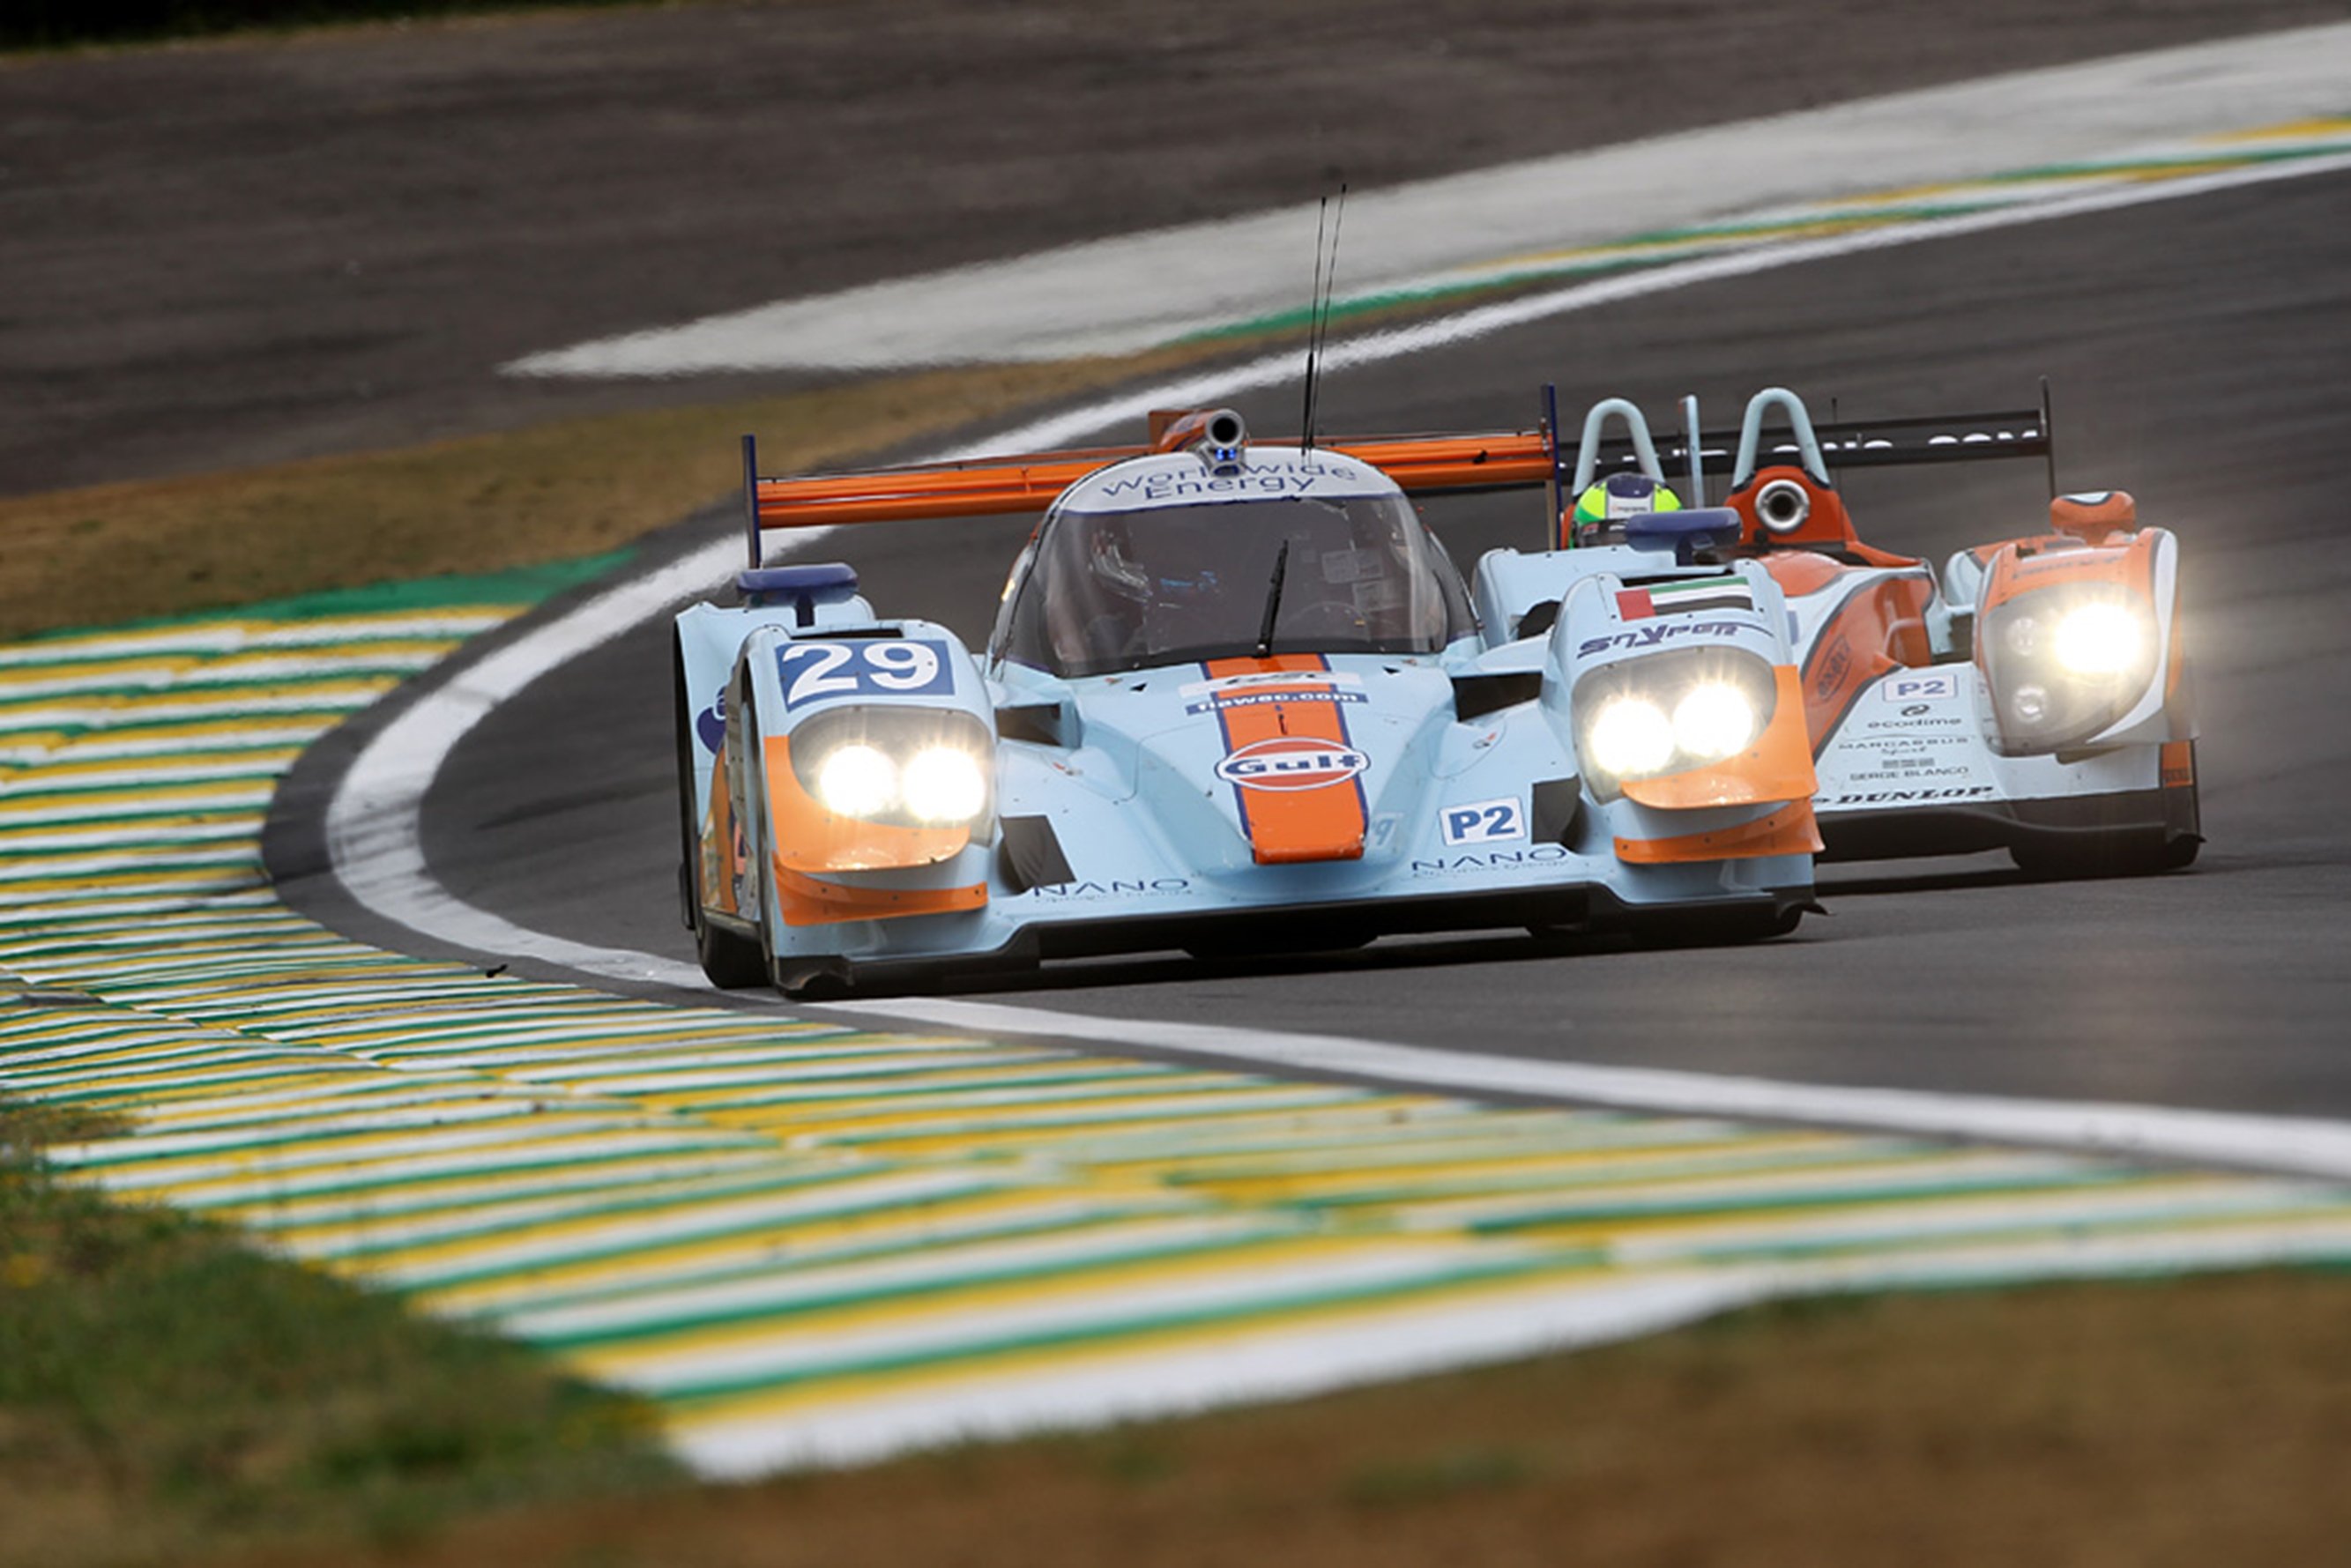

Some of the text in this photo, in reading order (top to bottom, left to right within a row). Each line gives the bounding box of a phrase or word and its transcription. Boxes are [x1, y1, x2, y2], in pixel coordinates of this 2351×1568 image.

[1102, 463, 1357, 496] Worlwide
[1145, 475, 1314, 500] Energy
[782, 642, 940, 705] 29
[1897, 680, 1946, 696] P2
[1224, 754, 1361, 775] Gulf
[1904, 766, 1968, 778] BLANCO
[1836, 785, 1994, 805] DUNLOP
[1448, 805, 1517, 840] P2
[1411, 846, 1567, 872] NANO
[1034, 878, 1189, 897] NANO
